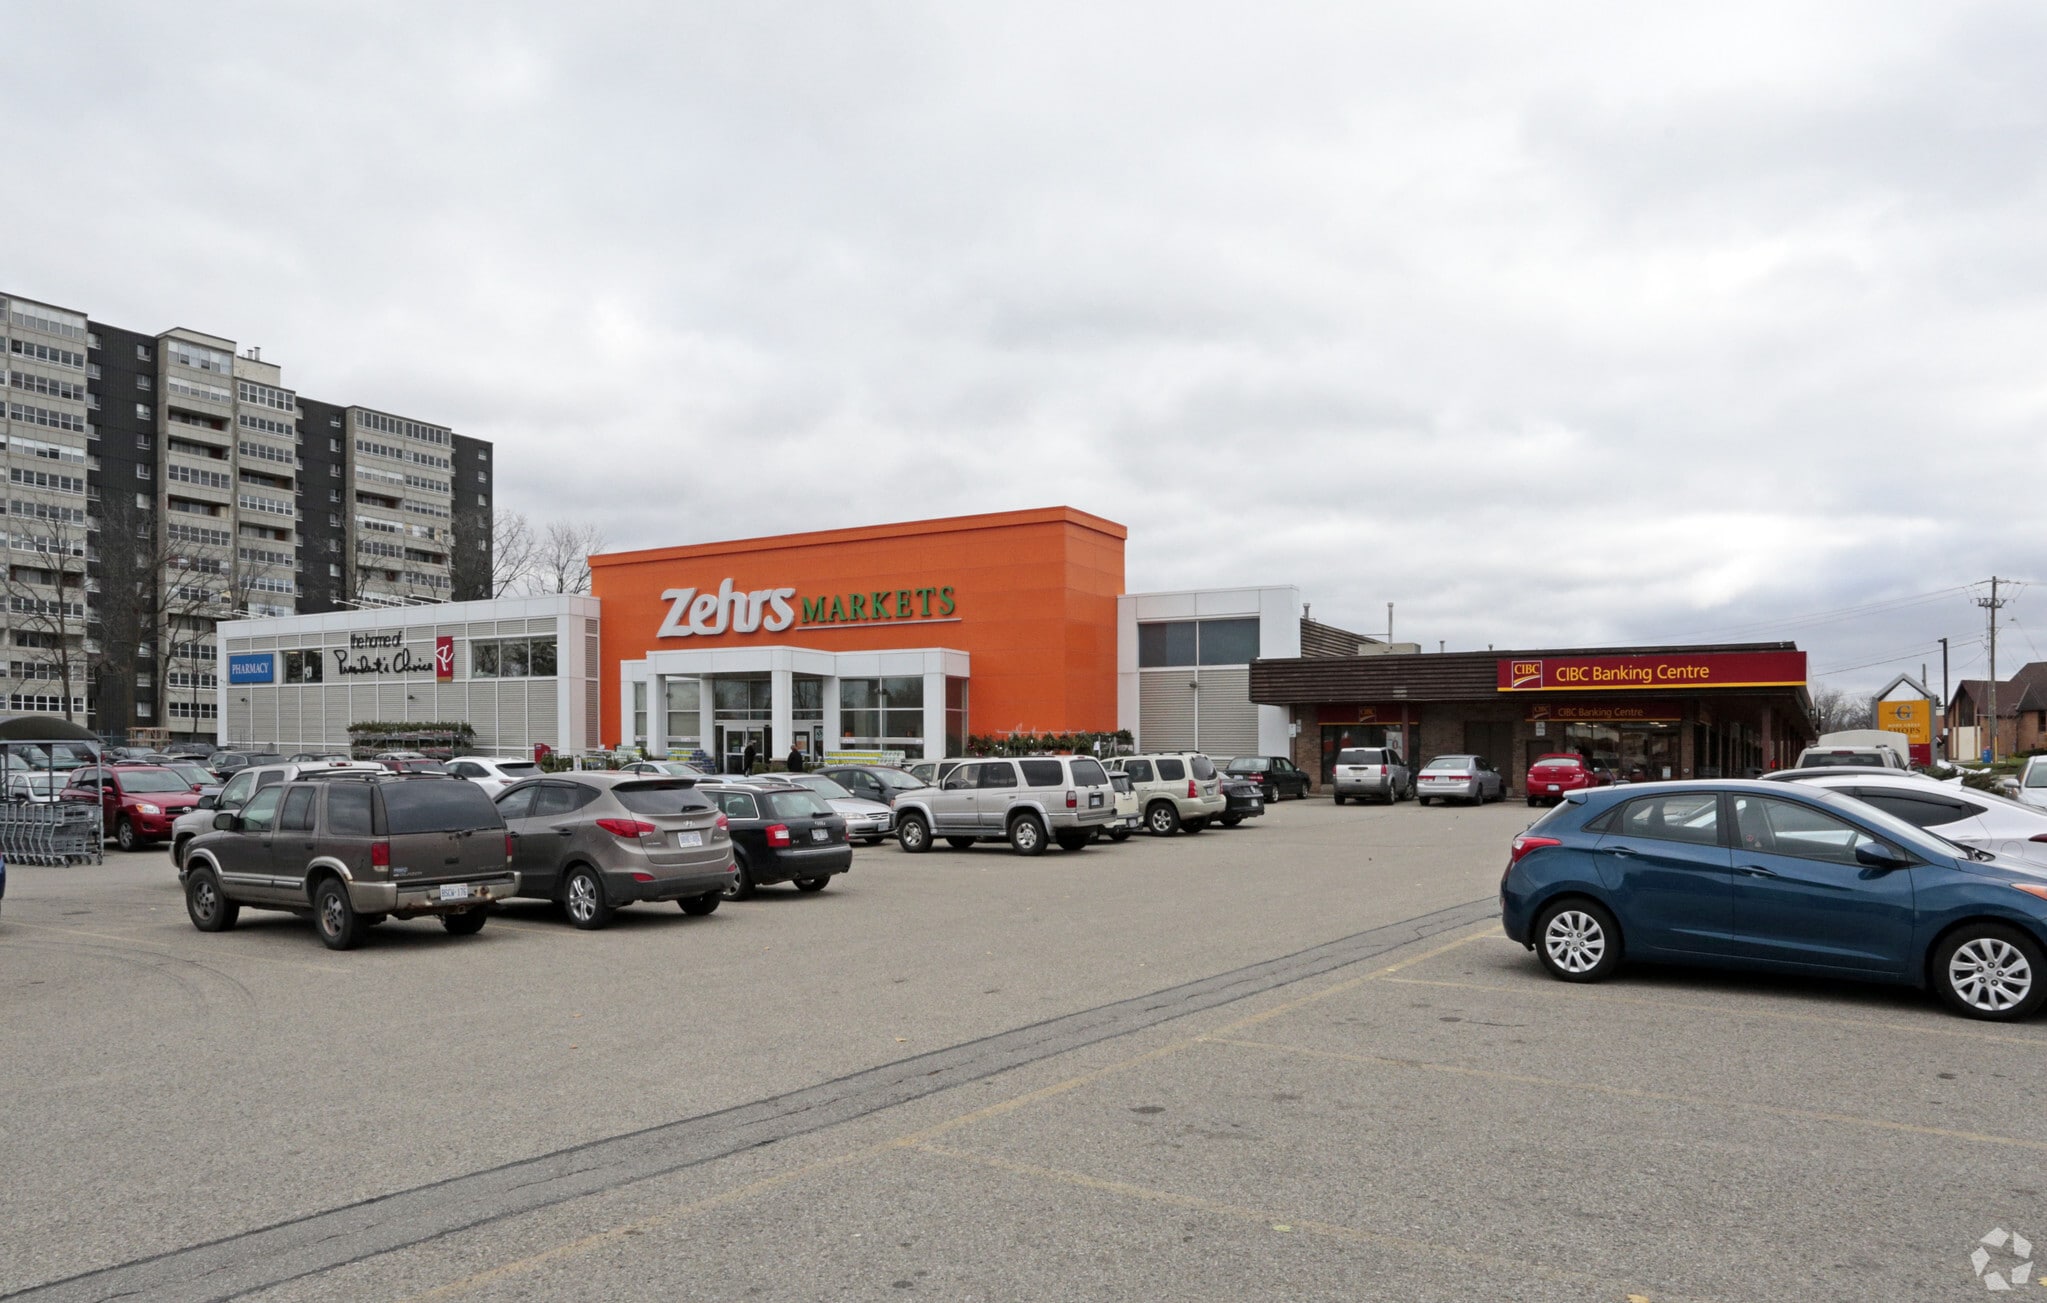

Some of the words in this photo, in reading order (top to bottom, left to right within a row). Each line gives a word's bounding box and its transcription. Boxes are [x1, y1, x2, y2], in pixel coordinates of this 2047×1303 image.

[656, 577, 796, 638] Zehrs
[801, 586, 956, 623] MARKETS
[350, 633, 364, 649] the
[365, 632, 390, 648] home
[391, 630, 402, 647] of
[231, 662, 270, 675] PHARMACY
[392, 648, 434, 673] Choice
[1514, 663, 1540, 675] CIBC
[1556, 666, 1589, 681] CIBC
[1593, 664, 1652, 683] Banking
[1657, 663, 1710, 679] Centre
[1558, 707, 1577, 717] CIBC
[1578, 707, 1613, 718] Banking
[1614, 706, 1644, 716] Centre
[1895, 704, 1912, 720] G
